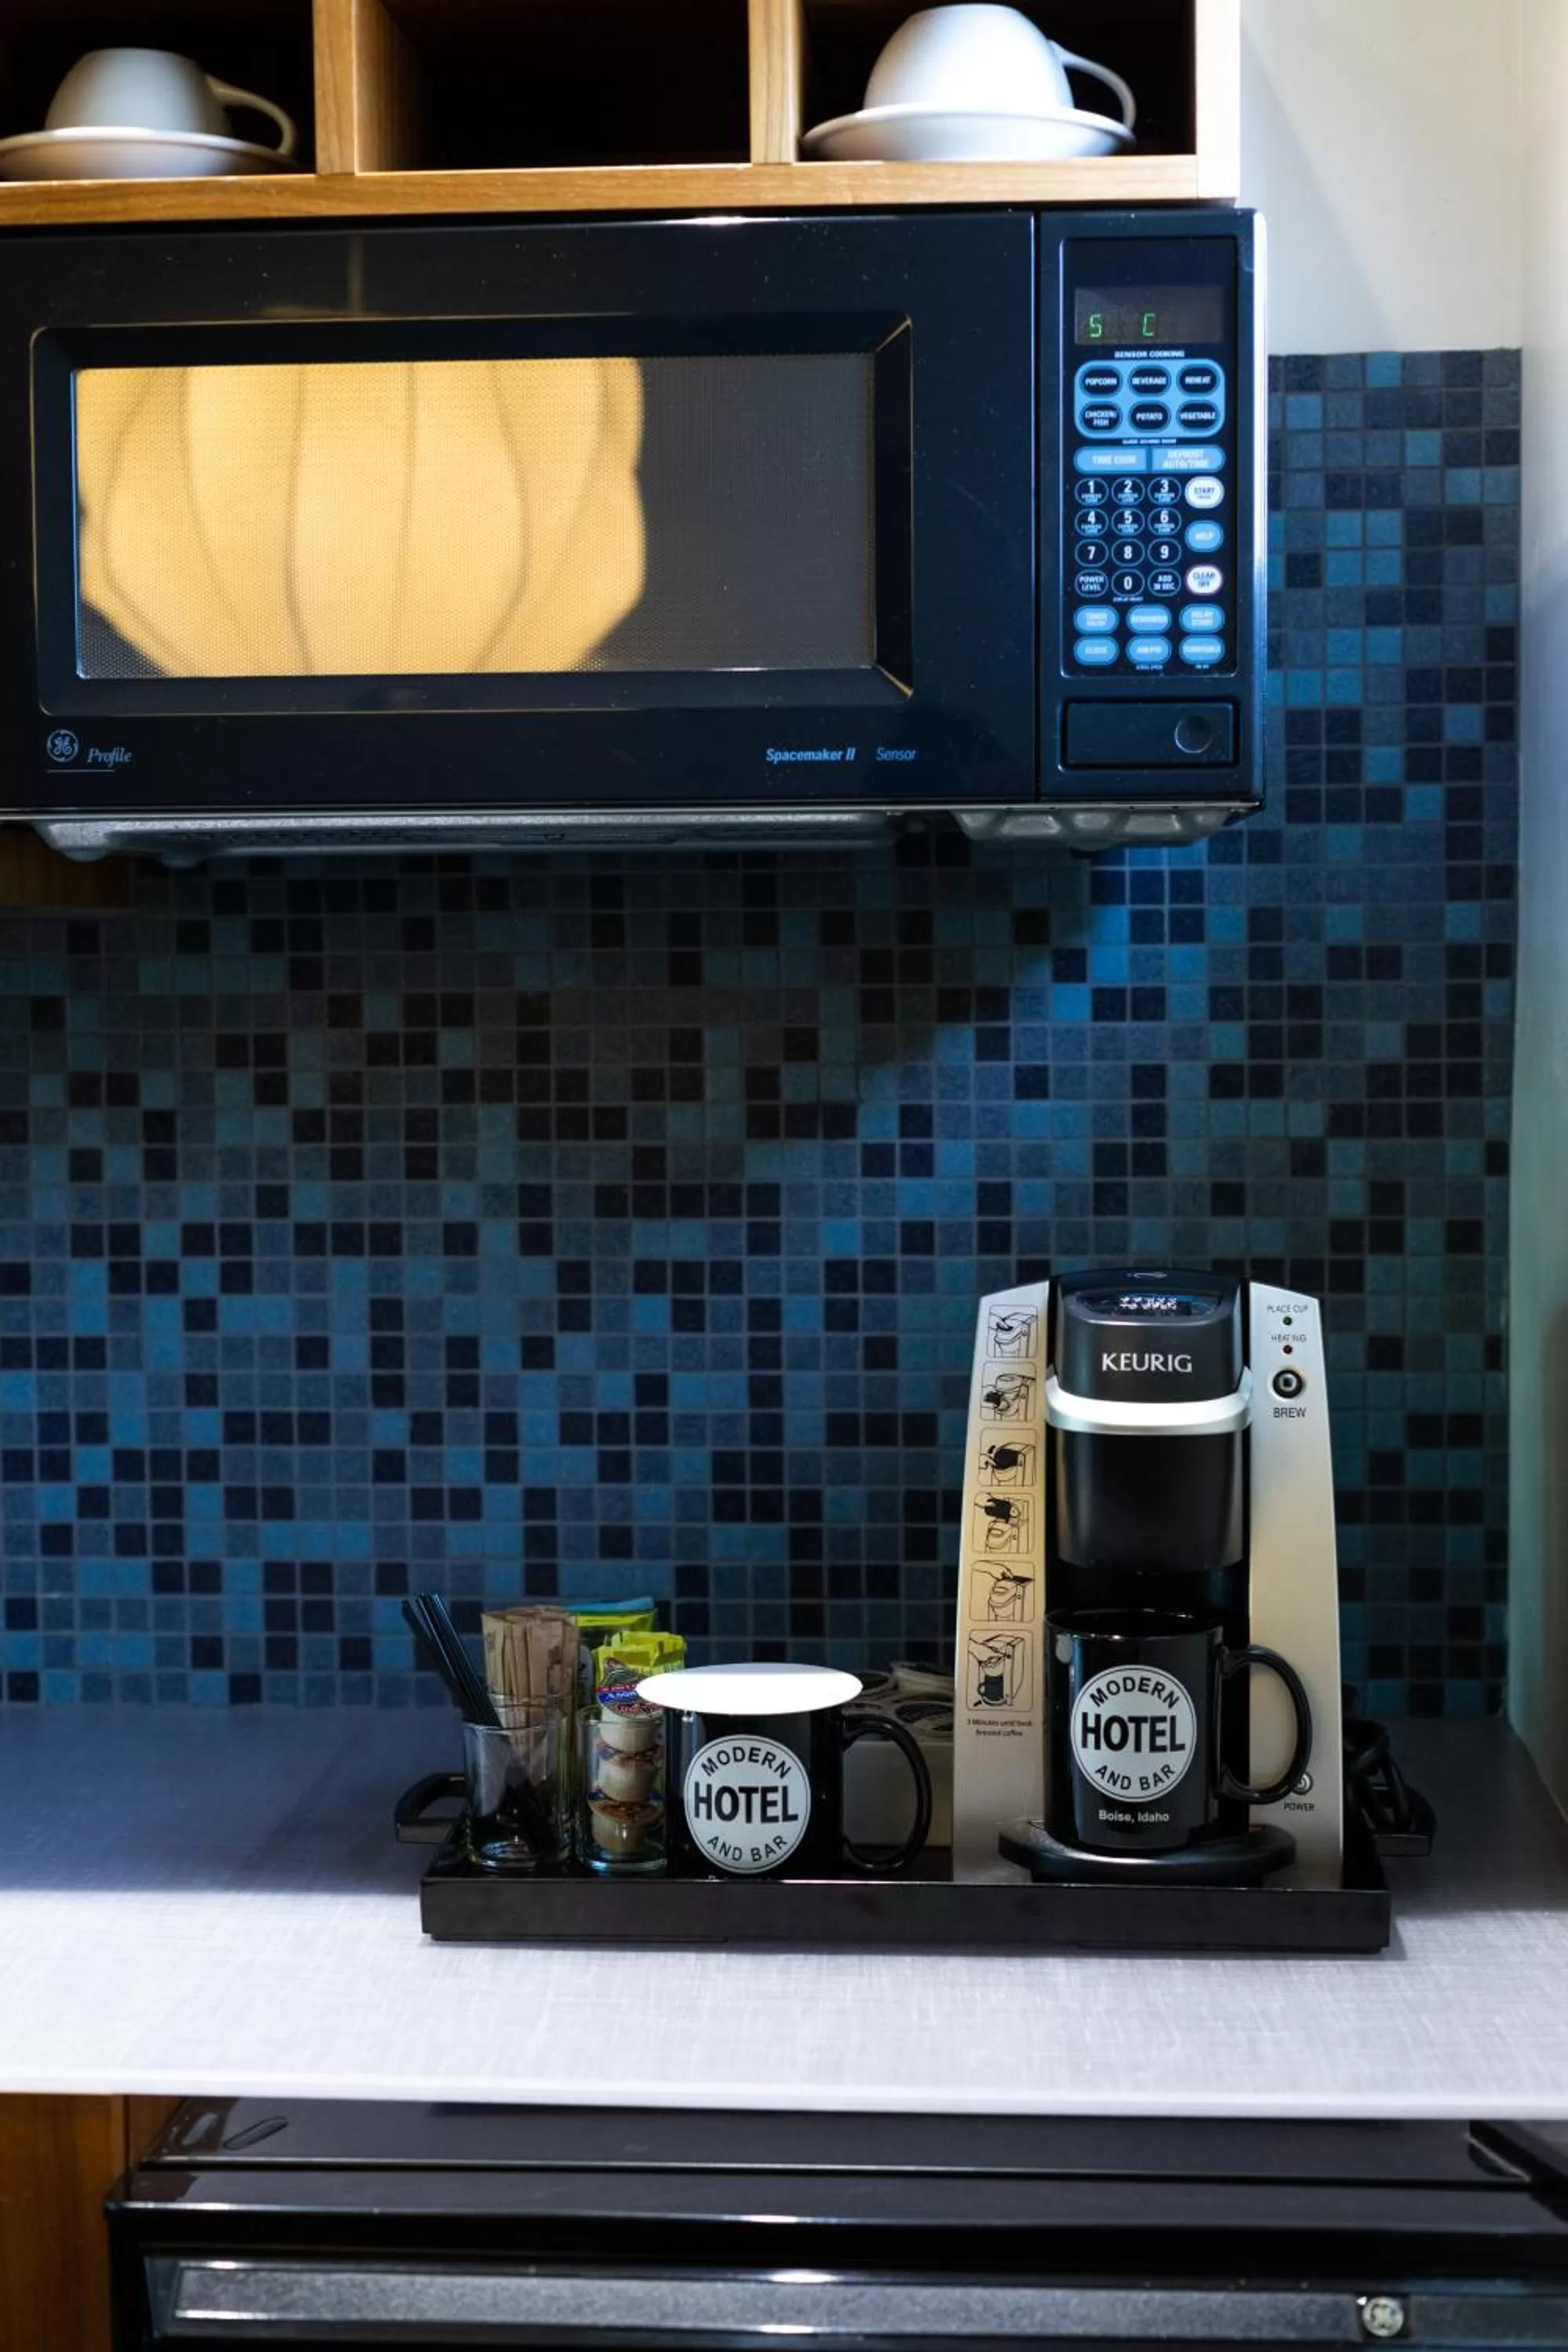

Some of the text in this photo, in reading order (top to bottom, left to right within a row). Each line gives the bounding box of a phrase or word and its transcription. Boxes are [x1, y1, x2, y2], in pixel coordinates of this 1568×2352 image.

[1085, 377, 1117, 386] POPCORN
[1131, 376, 1167, 385] BEVERAGE
[1185, 376, 1211, 384] REHEAT
[1087, 481, 1094, 493] 1
[1123, 480, 1133, 493] 2
[1160, 479, 1169, 493] 3
[1087, 510, 1095, 524] 4
[1123, 510, 1133, 524] 5
[1160, 510, 1169, 523] 6
[1087, 546, 1095, 561] 7
[1123, 546, 1132, 560] 8
[1160, 545, 1169, 560] 9
[1123, 575, 1133, 590] 0
[86, 746, 132, 768] Profile
[766, 748, 843, 764] Spacemaker
[876, 747, 916, 761] Sensor
[1102, 1352, 1192, 1373] KEURIG
[1273, 1408, 1307, 1418] BREW
[1089, 1676, 1180, 1708] MODERN
[1081, 1711, 1186, 1753] HOTEL
[700, 1746, 792, 1779] MODERN
[1094, 1764, 1176, 1791] AND BAR
[694, 1780, 799, 1824] HOTEL
[1098, 1809, 1170, 1824] Boise, Idaho
[707, 1835, 787, 1862] AND BAR
